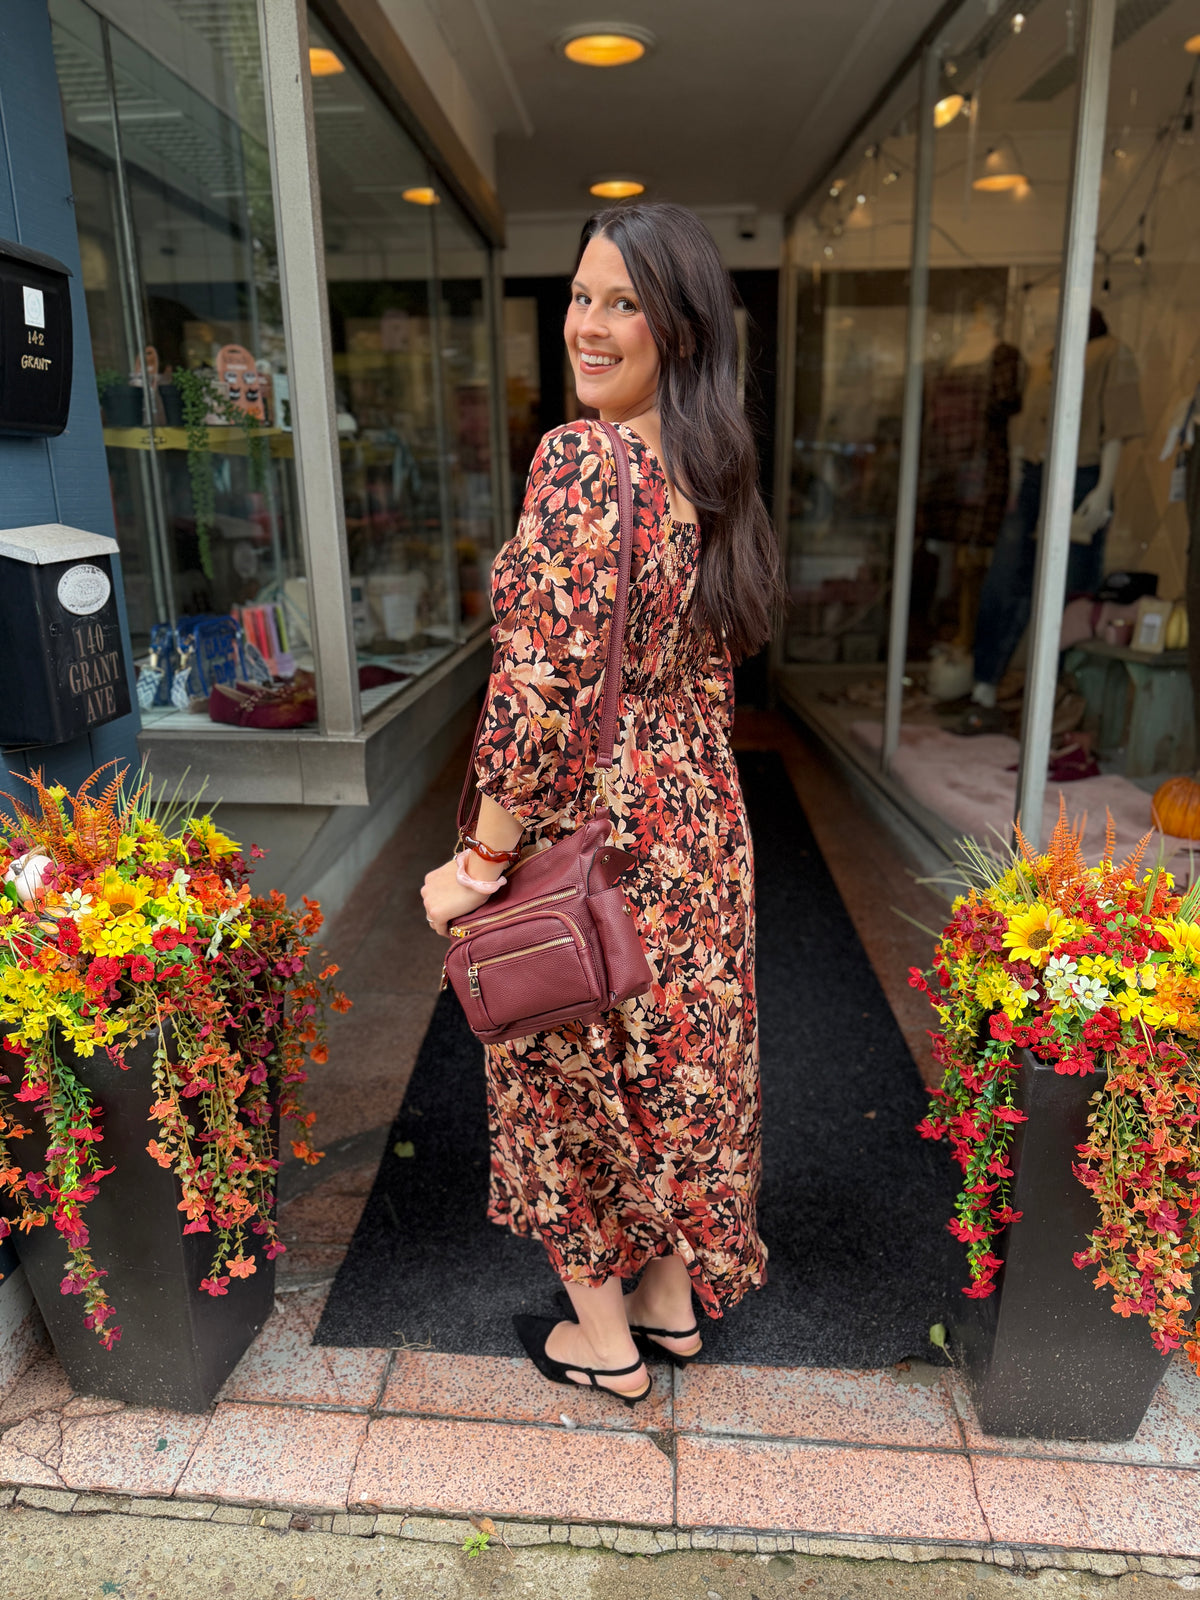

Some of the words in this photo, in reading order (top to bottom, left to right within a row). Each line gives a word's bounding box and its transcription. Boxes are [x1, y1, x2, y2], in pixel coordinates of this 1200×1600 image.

[28, 330, 45, 346] 142
[21, 354, 52, 371] GRANT
[76, 623, 104, 658] 140
[69, 651, 119, 694] GRANT
[87, 685, 116, 723] AVE
